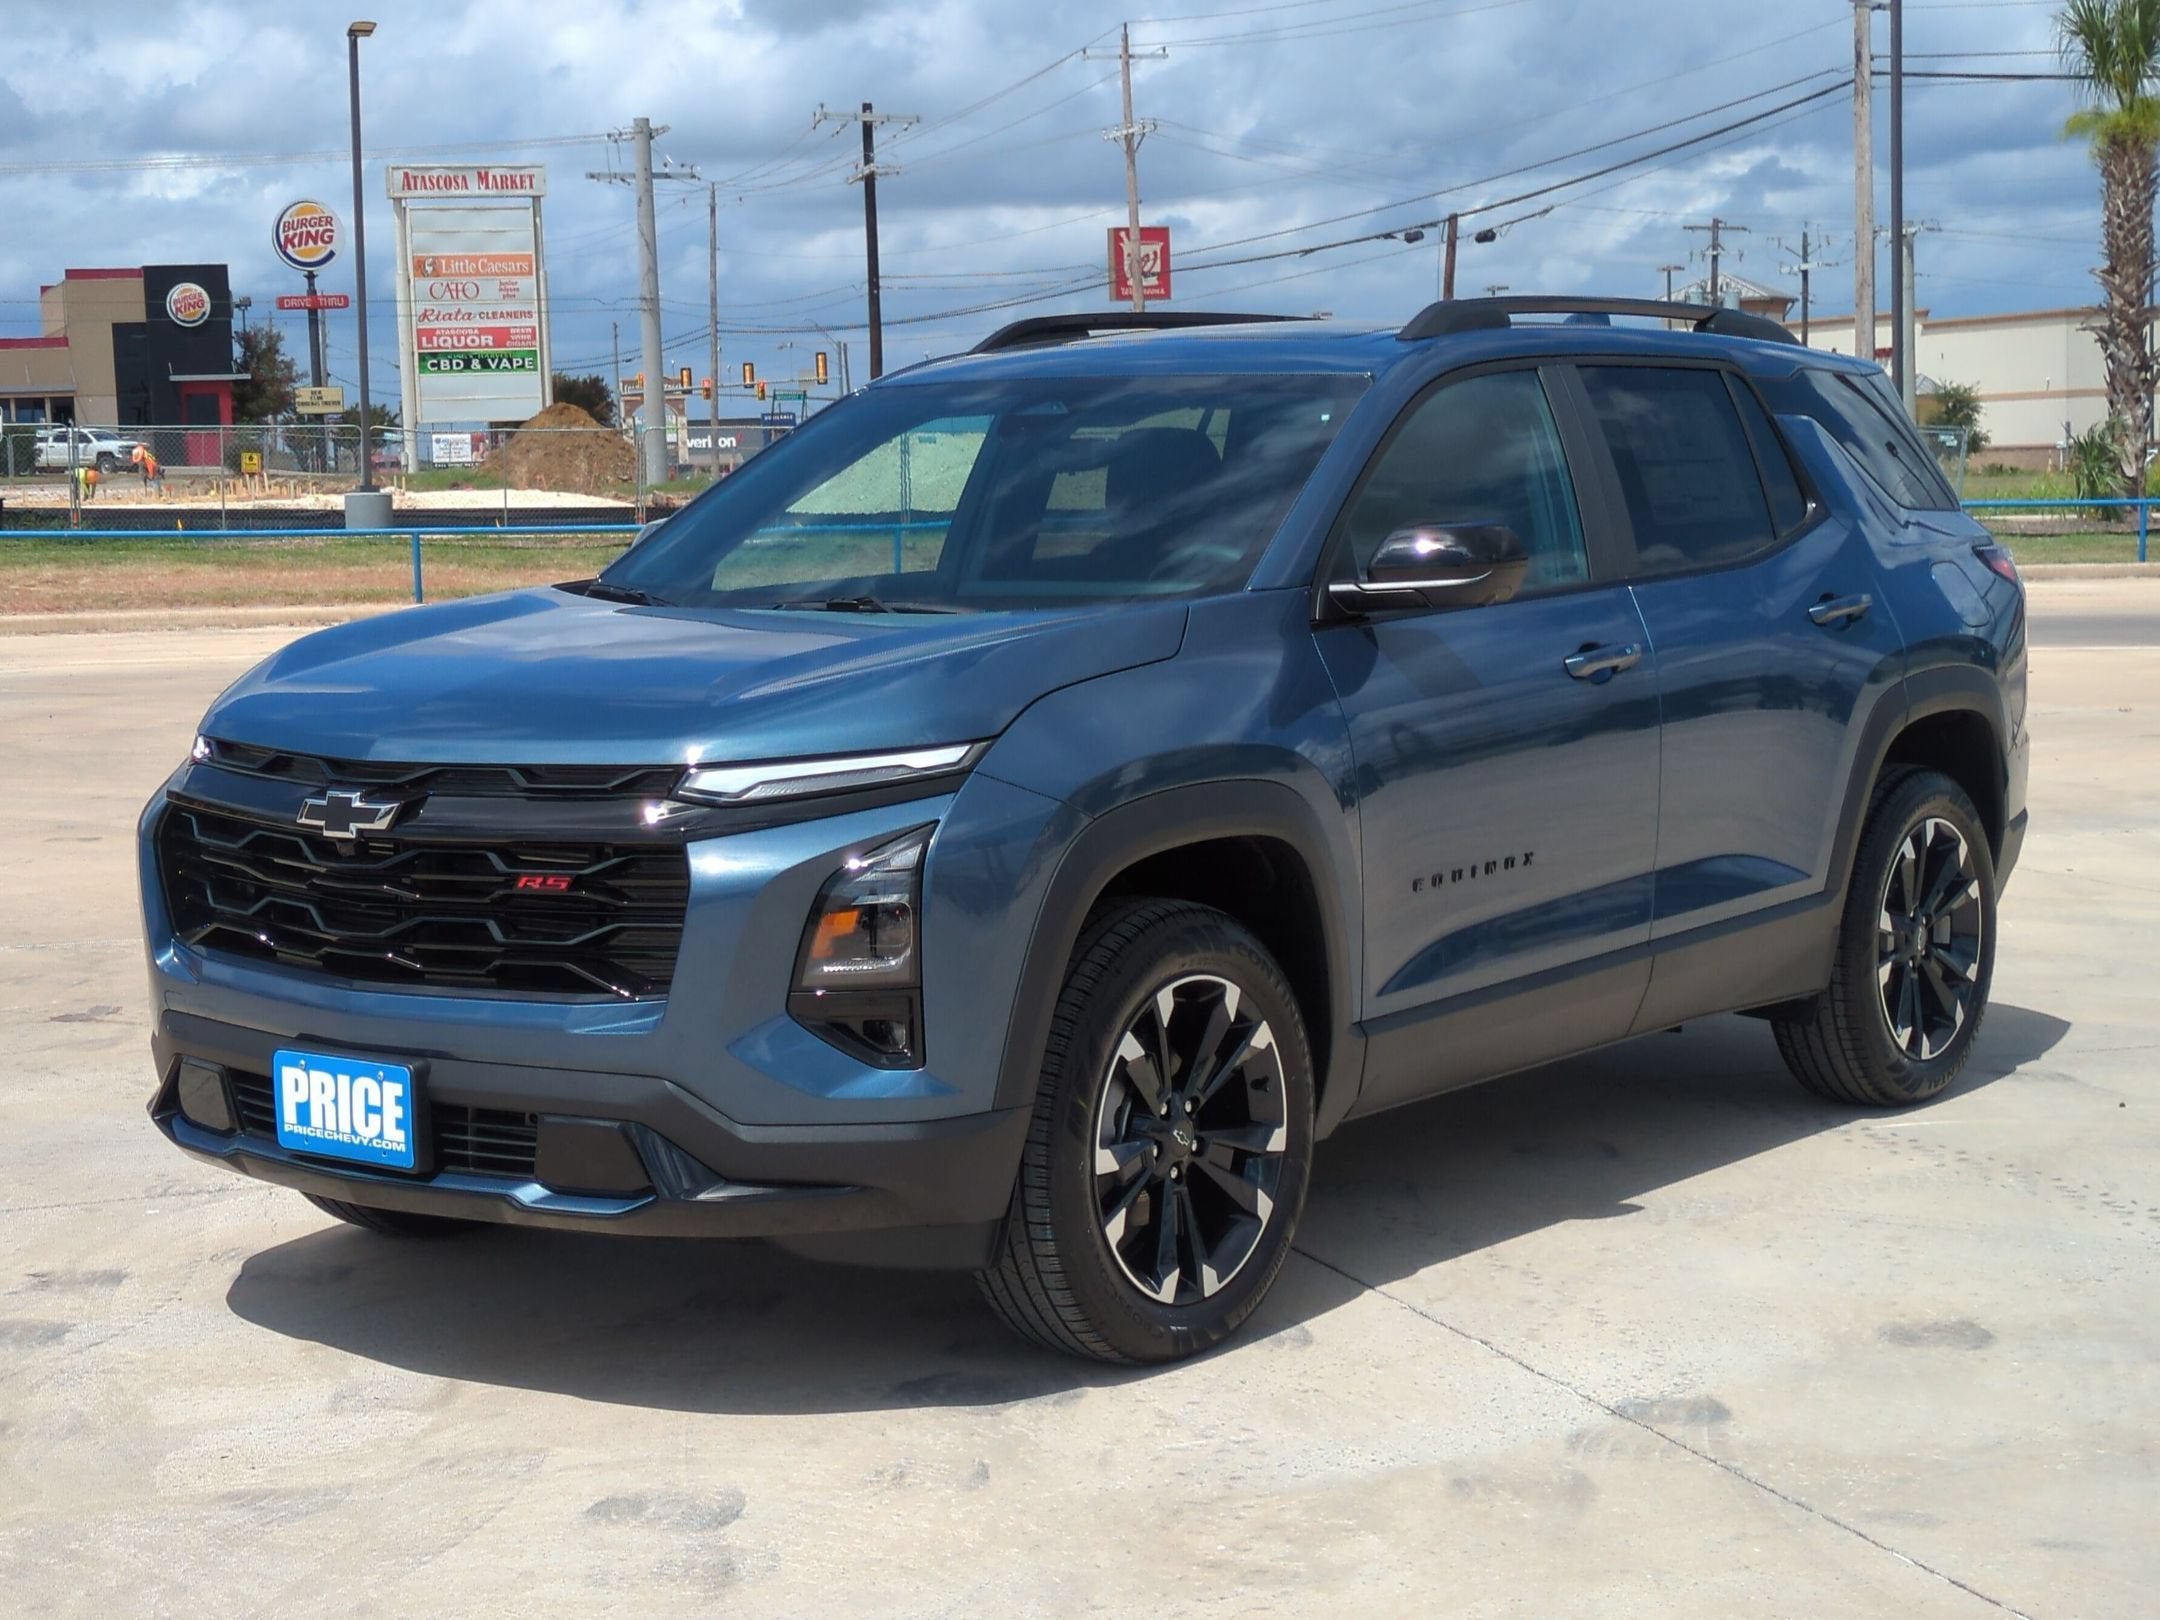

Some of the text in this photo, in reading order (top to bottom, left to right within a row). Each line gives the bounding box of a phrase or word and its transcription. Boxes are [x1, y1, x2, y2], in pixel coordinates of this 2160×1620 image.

[402, 170, 535, 191] ATASCOSA MARKET
[283, 216, 333, 233] BURGER
[282, 228, 335, 252] KING
[441, 258, 529, 273] Little Caesars
[429, 281, 480, 300] CATO
[175, 299, 205, 317] KING
[284, 297, 345, 308] DRIVE THRU
[478, 310, 534, 320] CLEANERS
[421, 335, 494, 349] LIQUOR
[427, 359, 464, 371] CBD
[470, 358, 481, 370] &
[487, 357, 534, 370] VAPE
[687, 435, 737, 449] verion
[517, 875, 572, 892] RS
[281, 1065, 406, 1142] PRICE
[284, 1123, 406, 1153] PRICECHEVY.COM
